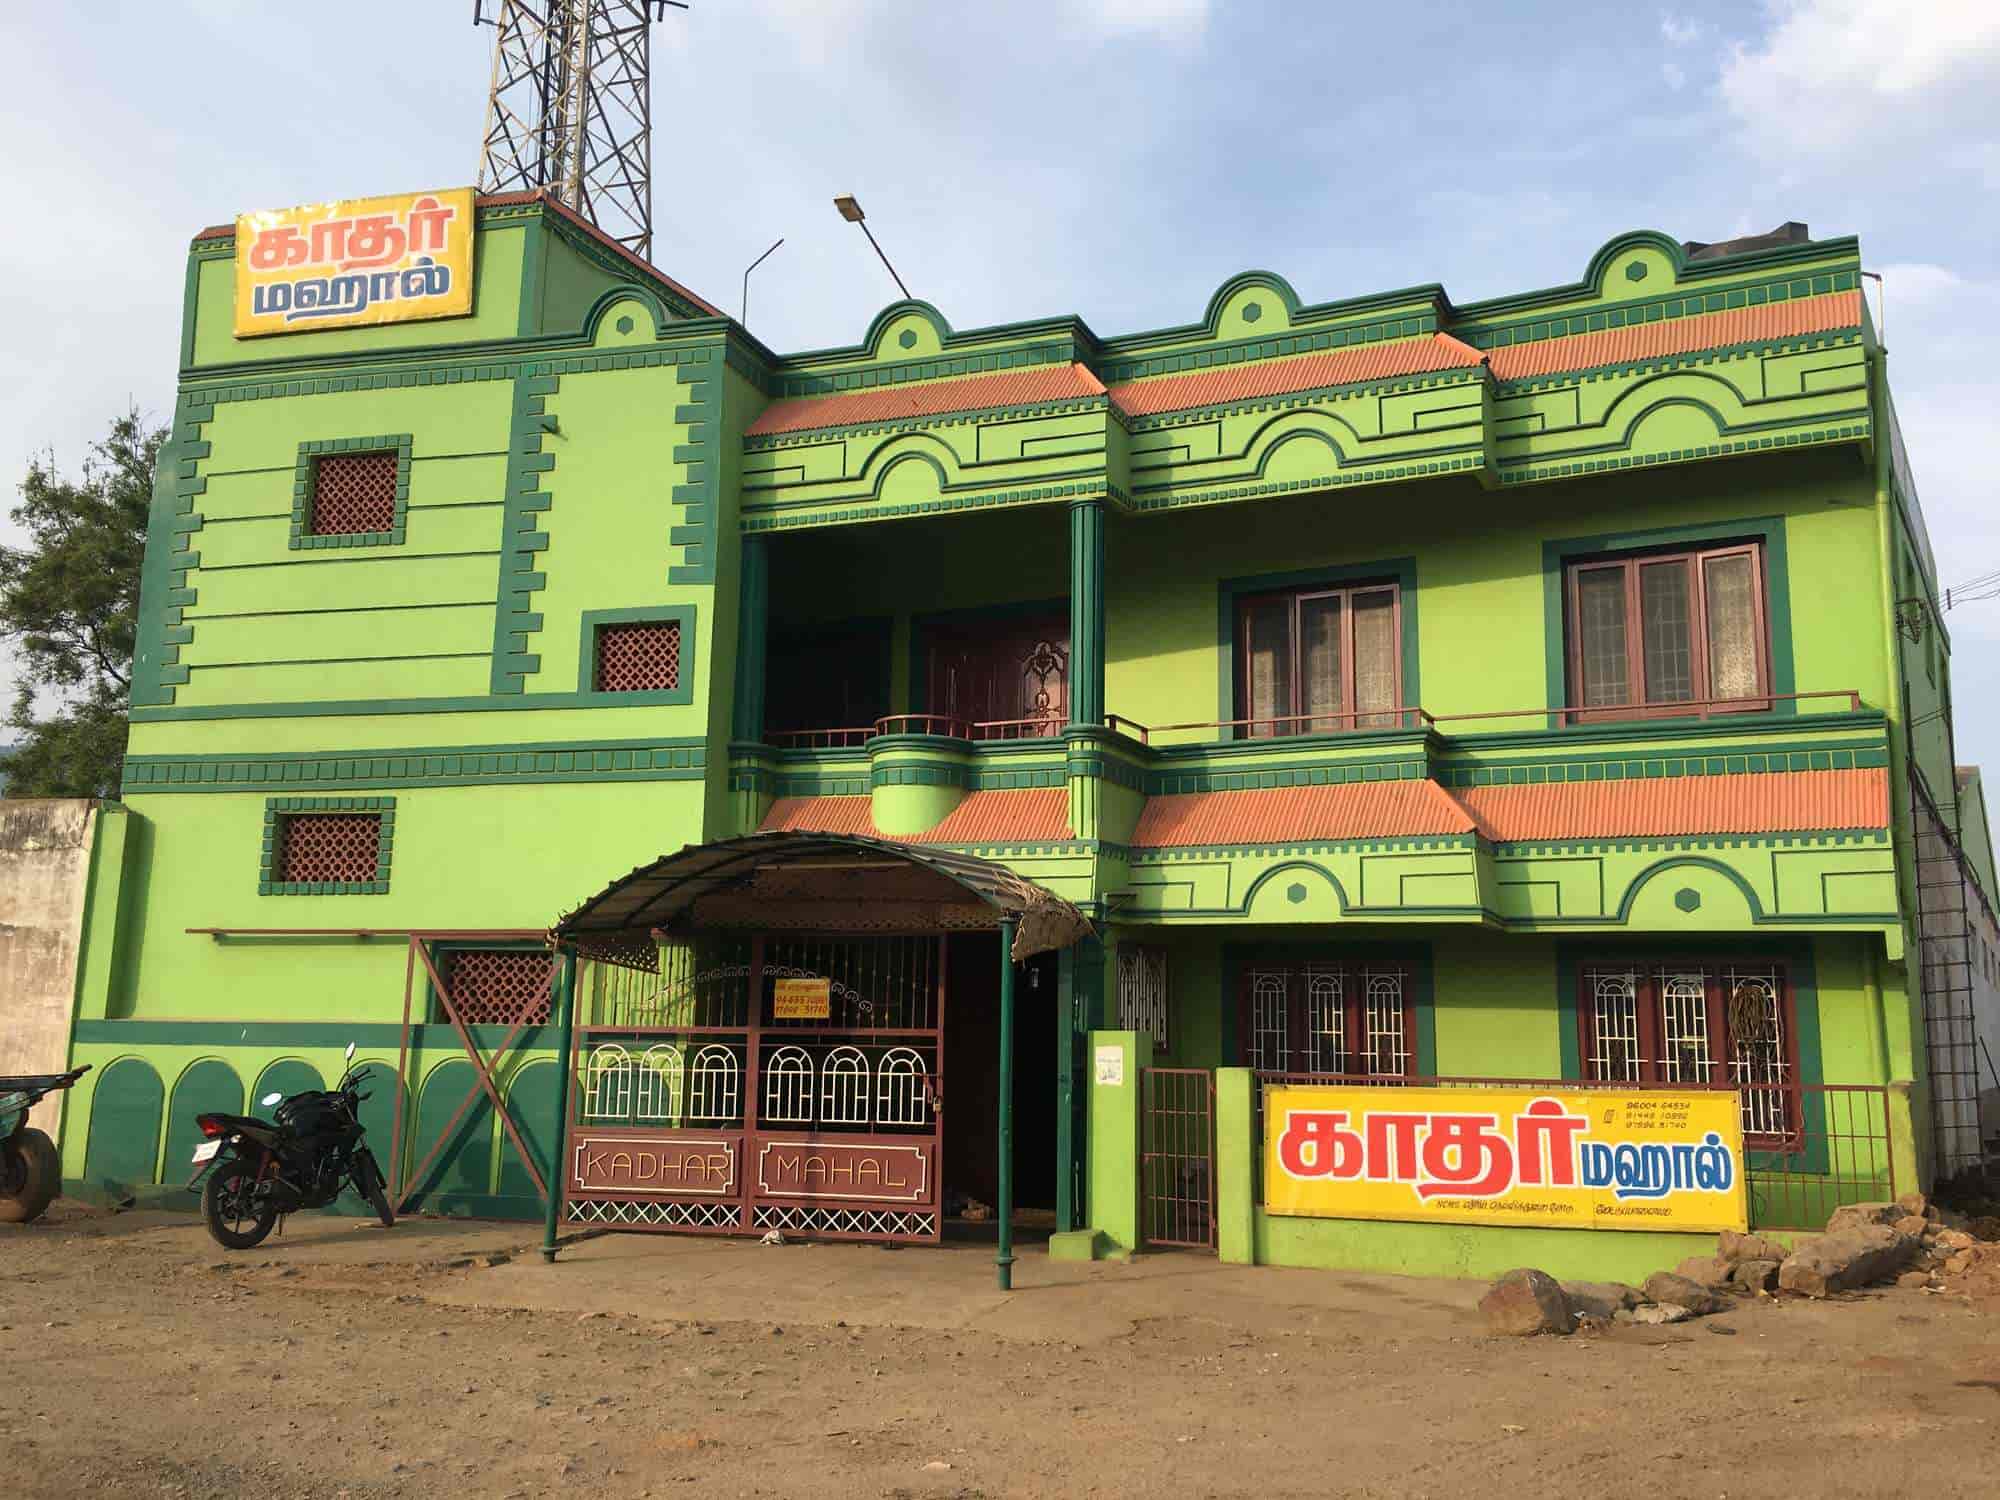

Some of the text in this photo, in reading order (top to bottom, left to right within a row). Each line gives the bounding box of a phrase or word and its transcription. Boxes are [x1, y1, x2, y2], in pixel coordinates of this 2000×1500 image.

[251, 198, 453, 270] காதர்
[254, 257, 450, 321] மஹால்
[586, 1152, 907, 1187] KADHAR MAHAL
[1280, 1100, 1732, 1199] காதர் மஹால்
